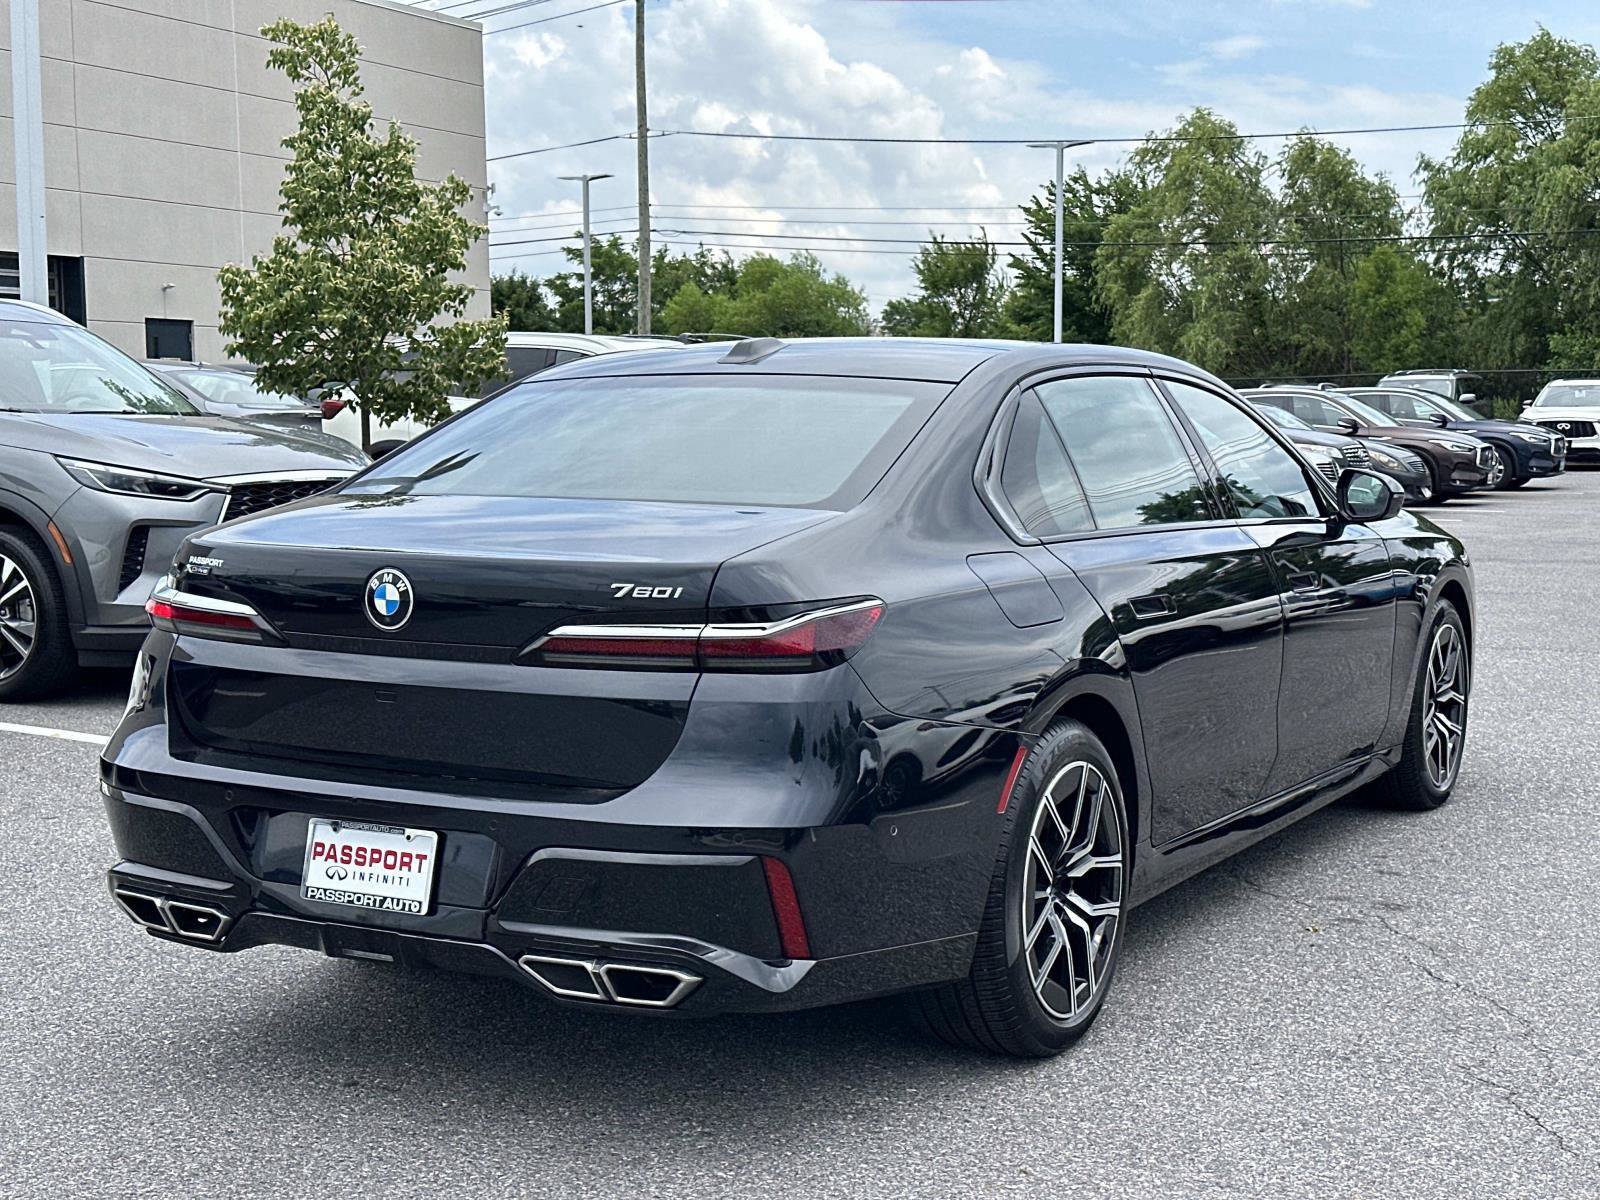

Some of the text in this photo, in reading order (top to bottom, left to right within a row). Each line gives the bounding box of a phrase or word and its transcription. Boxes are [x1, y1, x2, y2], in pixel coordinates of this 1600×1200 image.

[189, 555, 224, 567] PASSPORT
[370, 573, 407, 592] BMW
[312, 841, 428, 873] PASSPORT
[352, 871, 410, 887] INFINITI
